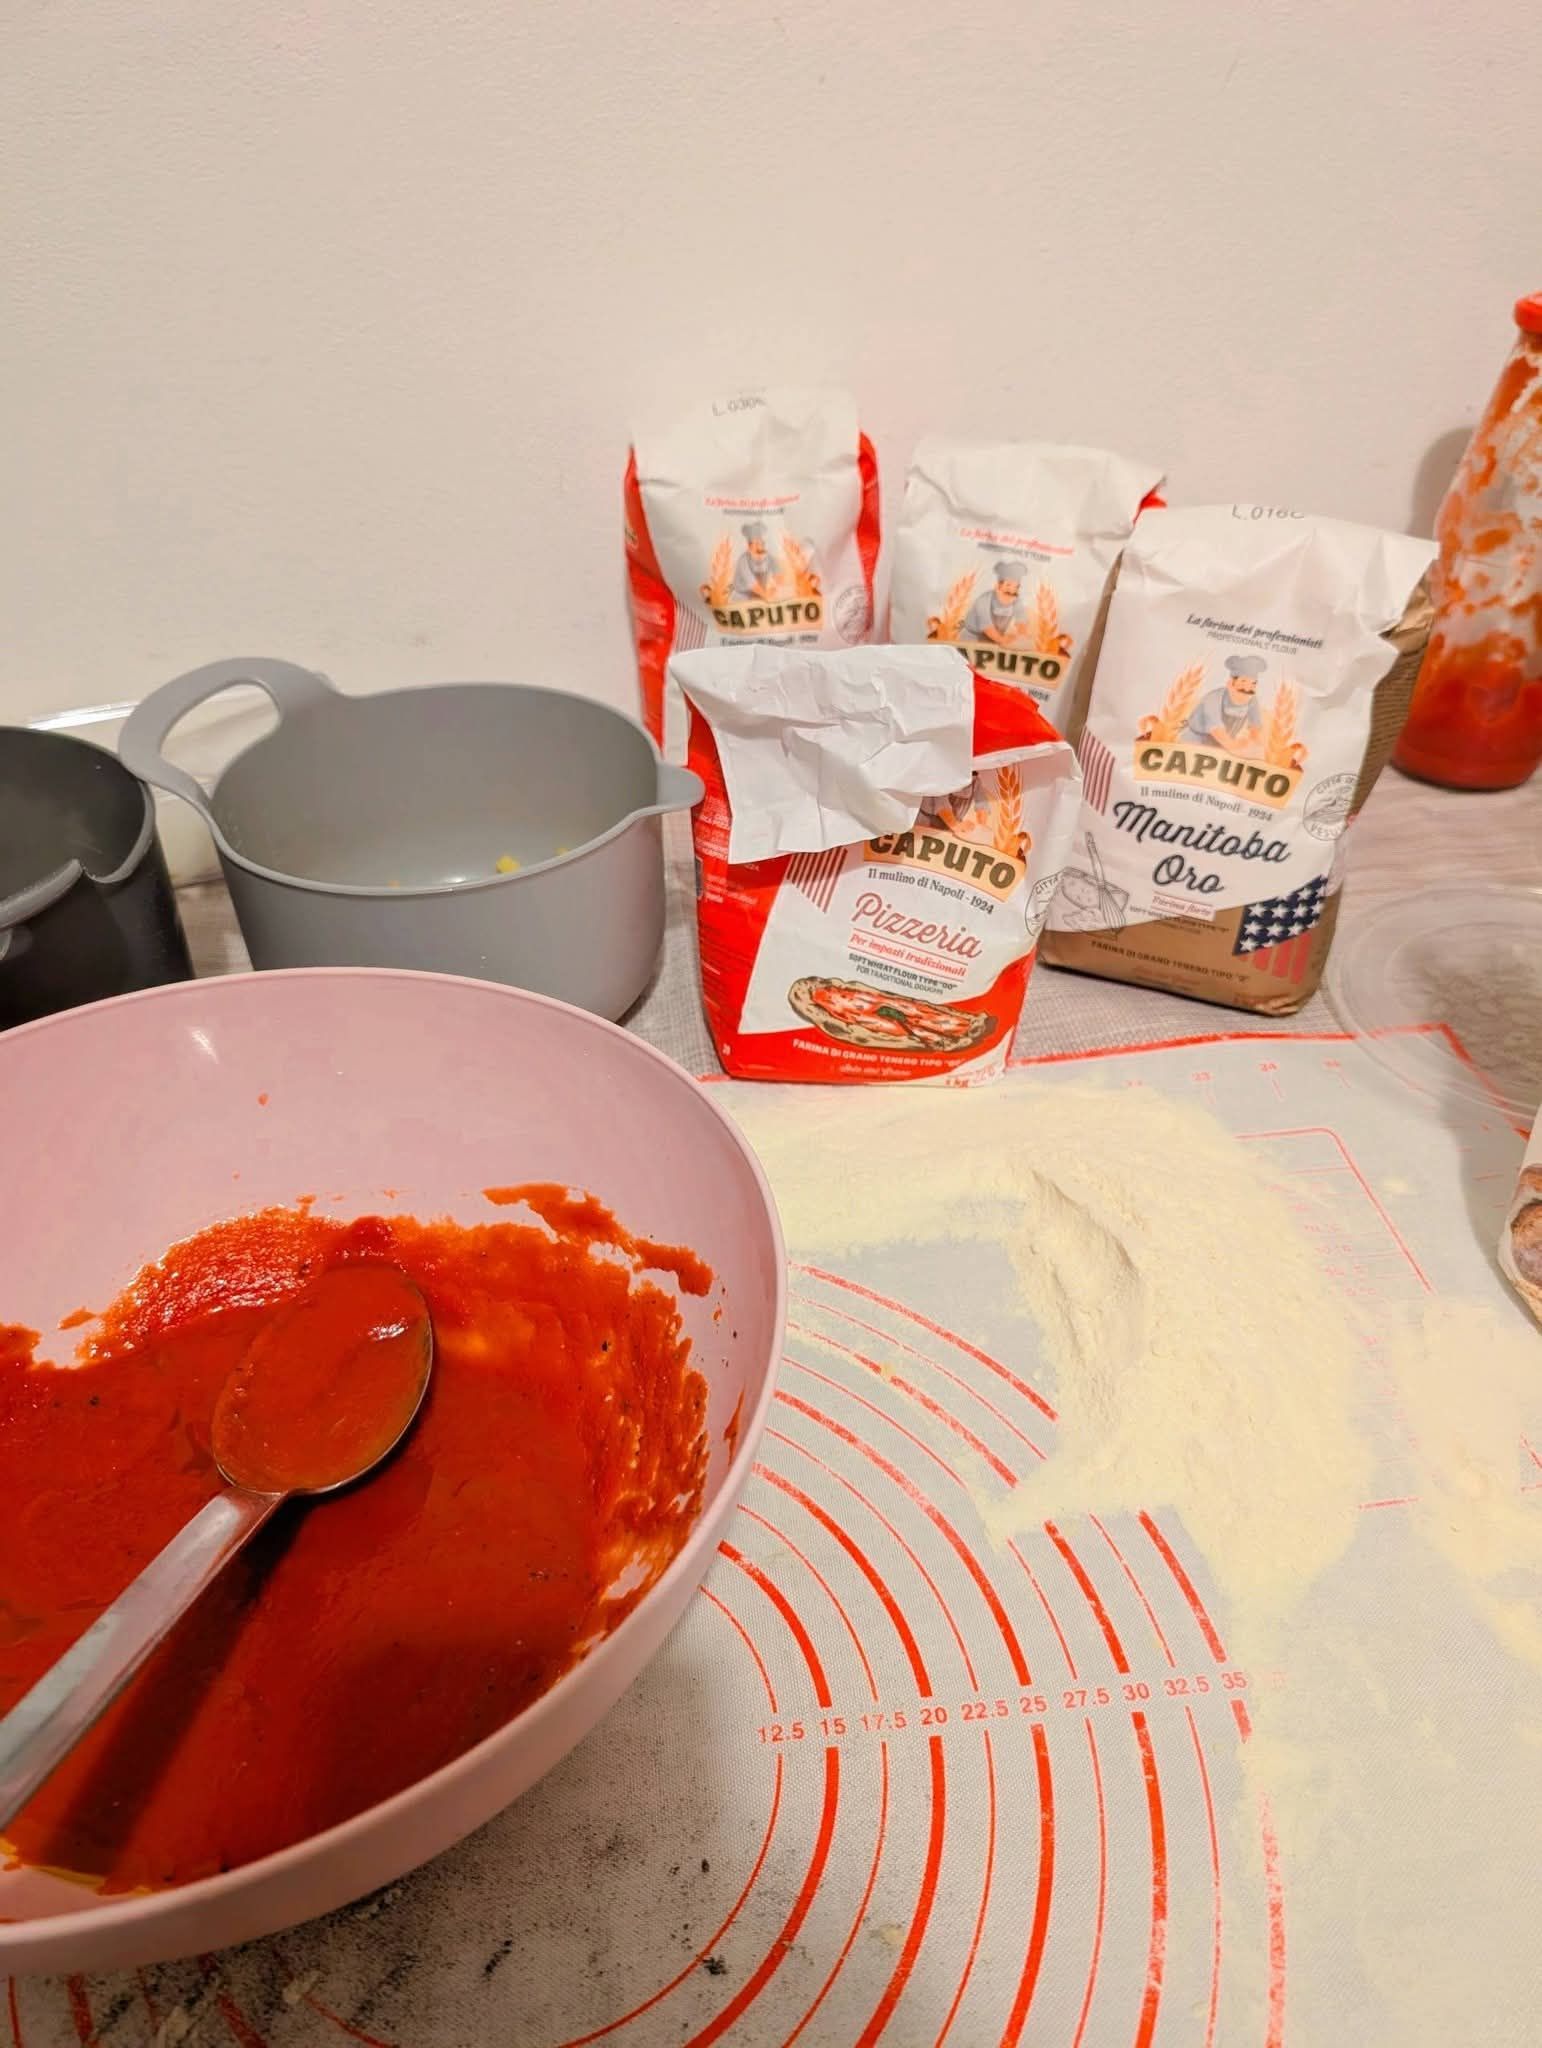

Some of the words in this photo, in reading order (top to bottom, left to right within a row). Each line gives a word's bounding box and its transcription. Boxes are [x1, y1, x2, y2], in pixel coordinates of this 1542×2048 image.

[712, 602, 820, 628] CAPUTO
[1140, 747, 1290, 798] CAPUTO
[1140, 786, 1149, 797] Il
[1151, 787, 1190, 801] mulino
[1192, 790, 1203, 802] di
[1205, 794, 1241, 814] Napoli
[1248, 807, 1273, 821] 1924
[1113, 801, 1292, 863] Manitoba
[869, 832, 1016, 889] CAPUTO
[1153, 854, 1224, 894] Oro
[868, 867, 877, 879] Il
[879, 869, 916, 885] mulino
[917, 878, 928, 888] di
[930, 879, 966, 901] Napoli
[971, 895, 995, 915] 1924
[851, 892, 982, 958] Pizzeria
[849, 953, 867, 965] SOFT
[867, 957, 894, 973] WHEAT
[893, 964, 918, 981] FLOUR
[919, 974, 938, 987] TYPE
[850, 933, 868, 946] Per
[869, 937, 905, 959] impasti
[906, 951, 967, 977] tradizionali
[1091, 940, 1125, 955] FARINA
[1126, 949, 1136, 959] DI
[1137, 952, 1170, 967] GRANO
[1211, 968, 1233, 980] TIPO
[856, 965, 870, 976] FOR
[871, 968, 914, 989] TRADITIONAL
[792, 1039, 829, 1056] FARINA
[830, 1048, 842, 1058] DI
[843, 1050, 878, 1062] GRANO
[879, 1055, 918, 1066] TENERO
[920, 1057, 943, 1067] TIPO
[757, 1722, 805, 1744] 12.5
[819, 1717, 846, 1736] 15
[860, 1711, 907, 1731] 17.5
[920, 1706, 948, 1725] 20
[961, 1700, 1009, 1721] 22.5
[1019, 1696, 1047, 1714] 25
[1063, 1688, 1110, 1708] 27.5
[1122, 1683, 1149, 1700] 30
[1164, 1676, 1209, 1696] 32.5
[1221, 1672, 1247, 1689] 35
